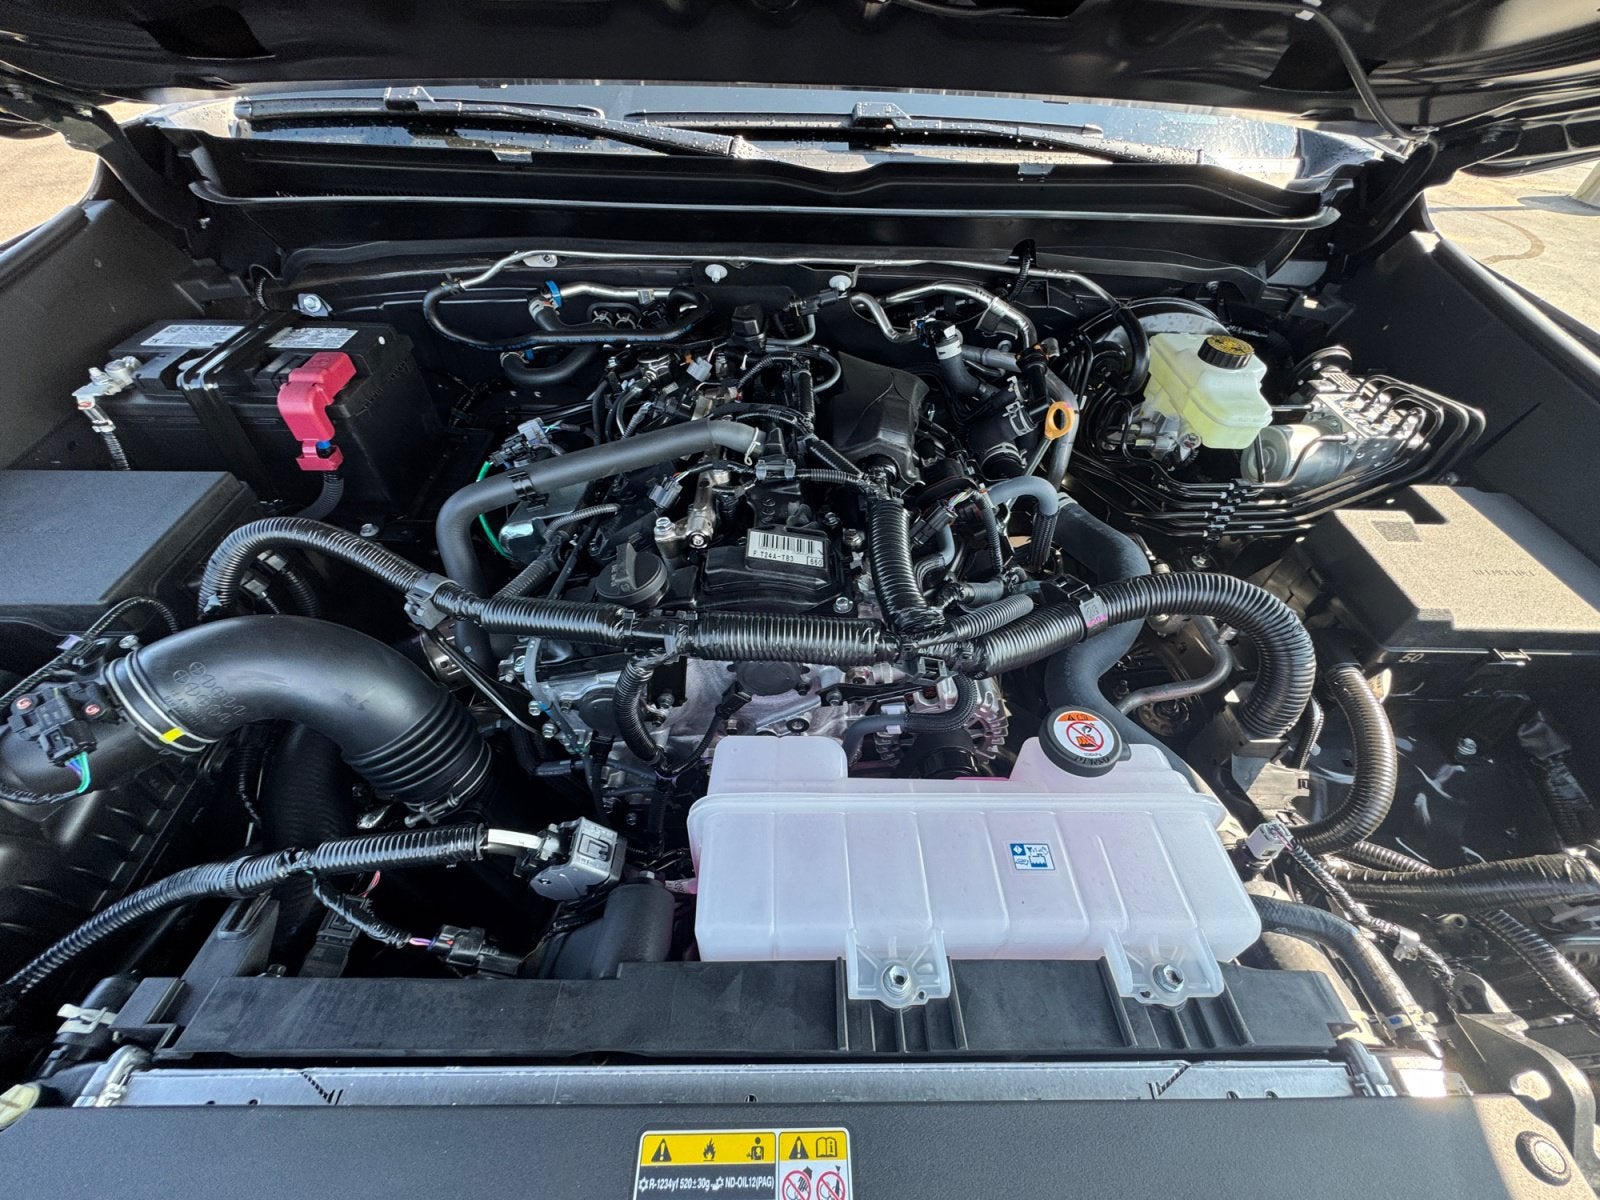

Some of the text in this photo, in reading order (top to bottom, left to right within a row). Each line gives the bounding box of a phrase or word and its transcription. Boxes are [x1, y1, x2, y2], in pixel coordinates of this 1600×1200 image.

[1398, 653, 1425, 663] 50
[649, 1176, 774, 1192] R-1234yf 520±30g ND-OIL12(PAG)
